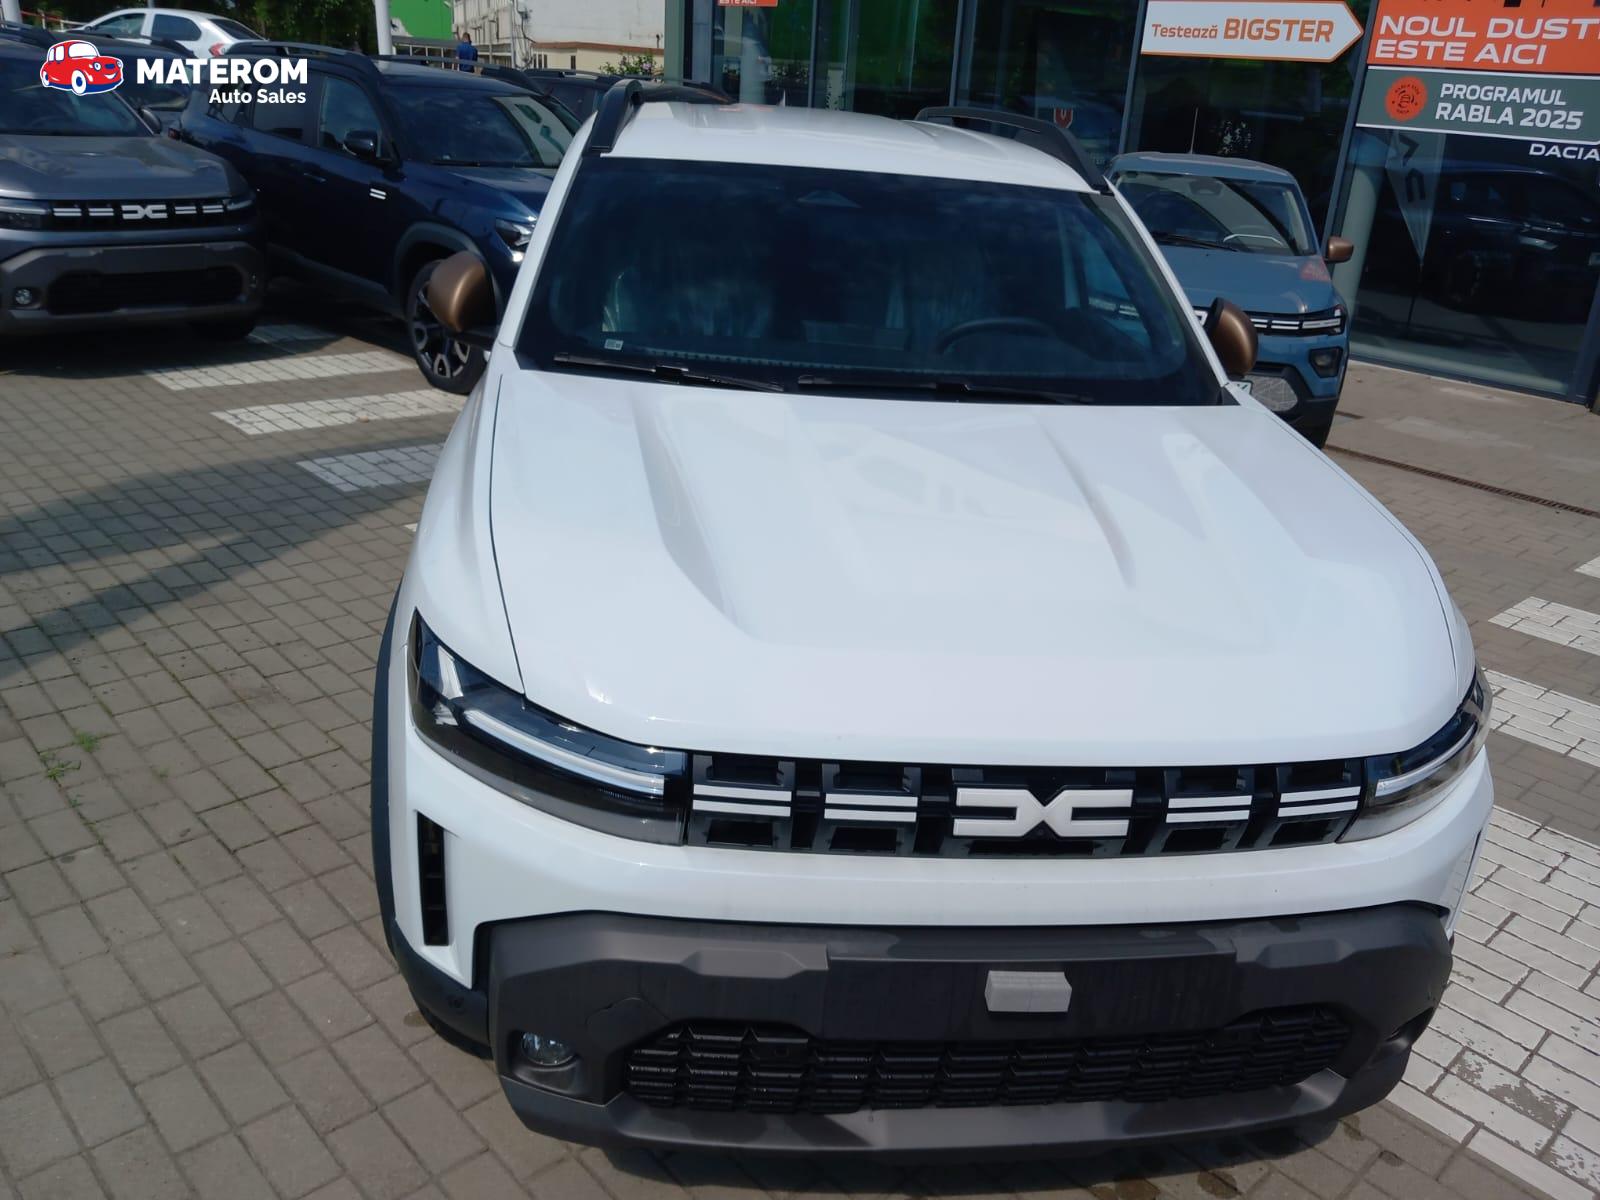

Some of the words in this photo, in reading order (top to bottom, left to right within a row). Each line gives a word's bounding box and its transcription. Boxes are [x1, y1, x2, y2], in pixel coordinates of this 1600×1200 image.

[1151, 23, 1218, 39] Testează
[1223, 18, 1335, 43] BIGSTER
[1379, 15, 1477, 37] NOUL
[1486, 18, 1600, 40] DUST
[1375, 39, 1468, 62] ESTE
[1473, 44, 1548, 65] AICI
[1439, 83, 1567, 106] PROGRAMUL
[1435, 102, 1515, 126] RABLA
[1519, 108, 1584, 131] 2025
[1528, 143, 1600, 161] DACIA
